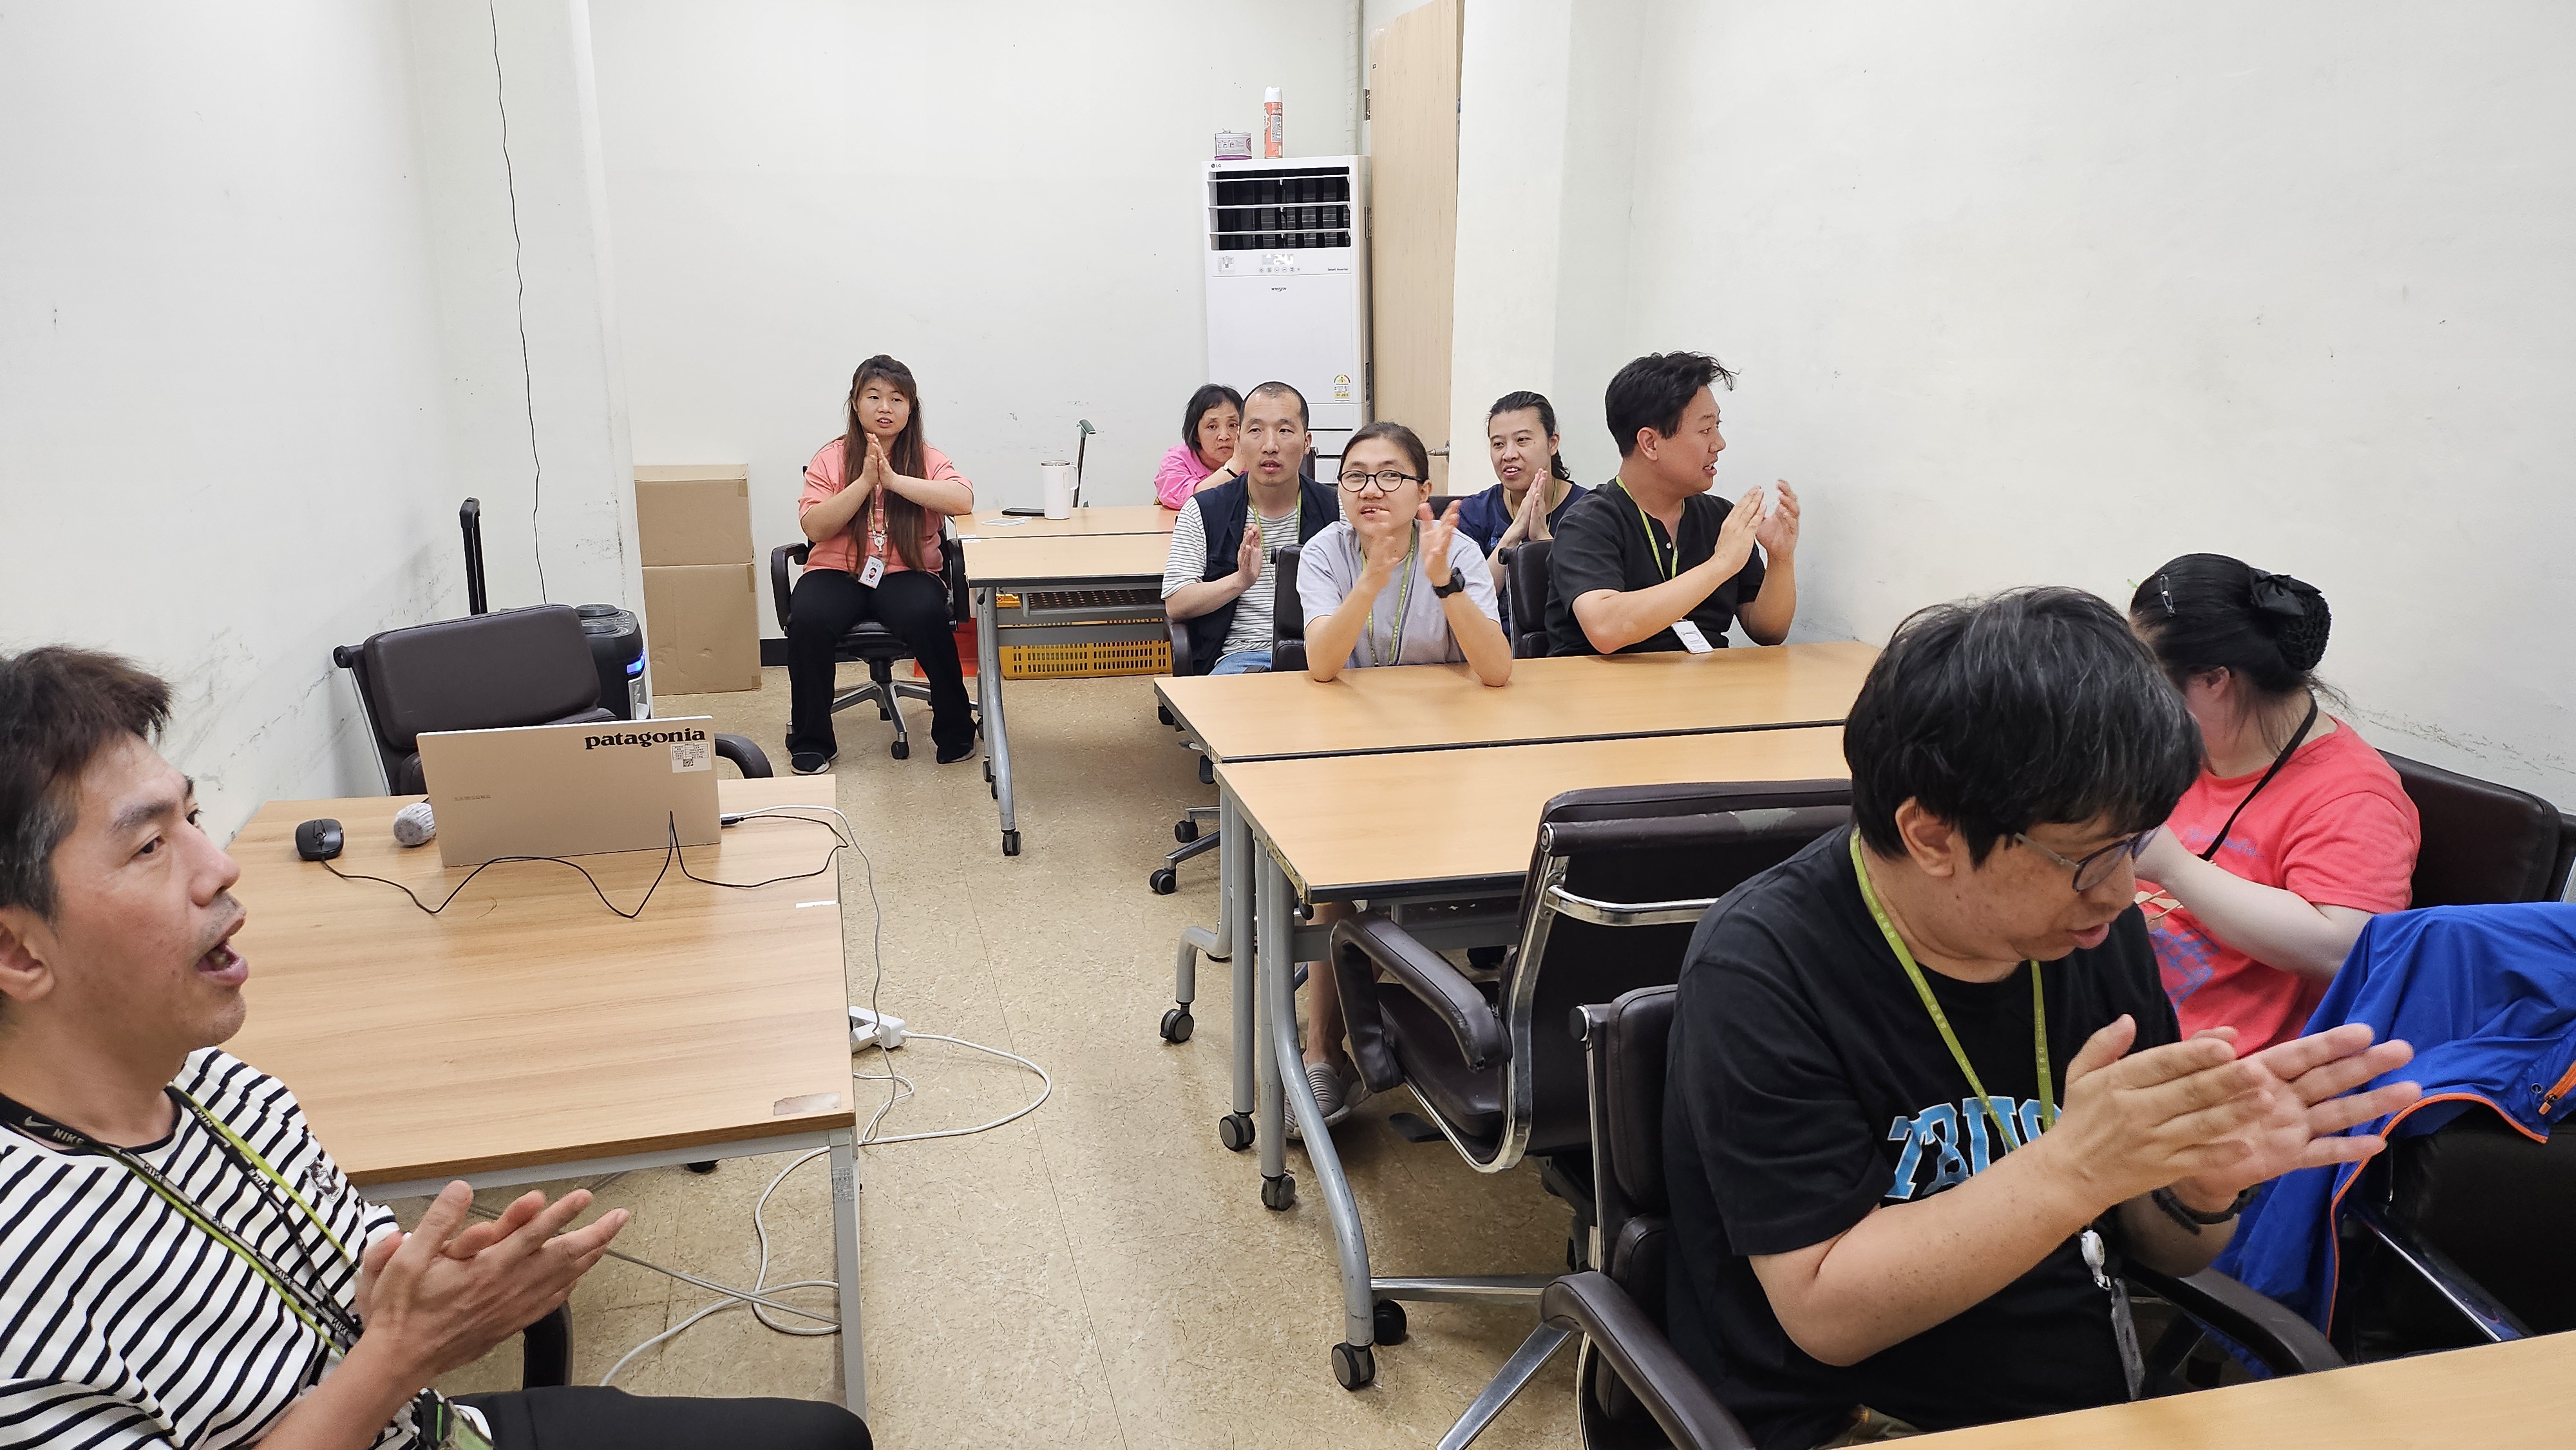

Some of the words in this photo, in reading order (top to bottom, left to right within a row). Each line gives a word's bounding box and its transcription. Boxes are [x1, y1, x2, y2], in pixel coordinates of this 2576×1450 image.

[584, 728, 706, 750] patagonia
[191, 1106, 213, 1128] NIKE
[53, 1127, 85, 1144] NIKE
[247, 1169, 269, 1193] NIKE
